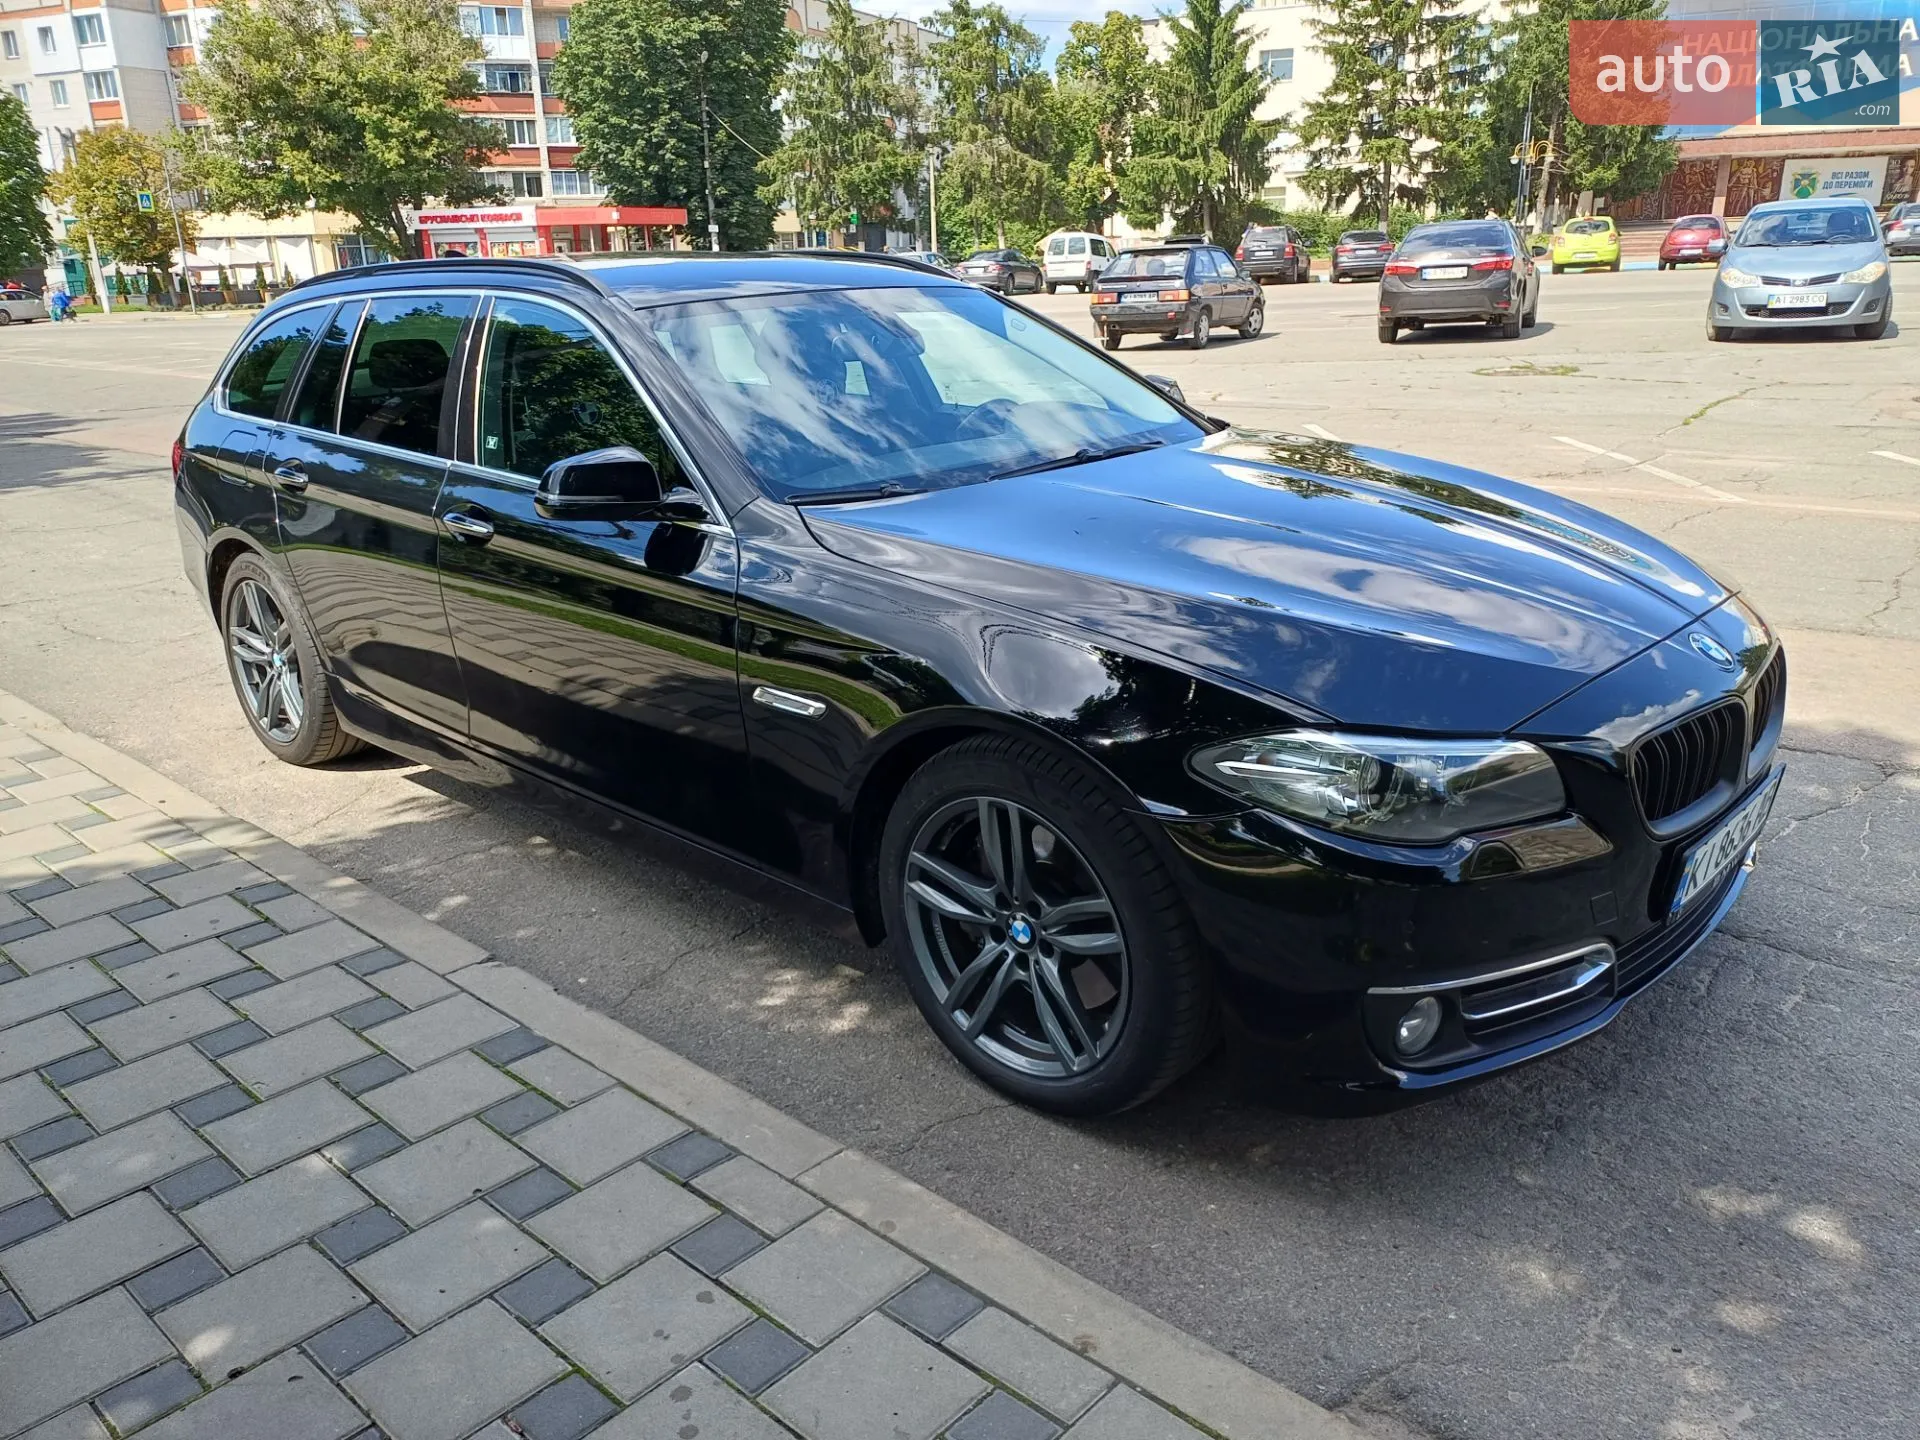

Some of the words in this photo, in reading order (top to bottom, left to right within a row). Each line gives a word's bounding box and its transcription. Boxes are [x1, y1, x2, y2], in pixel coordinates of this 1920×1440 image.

[1831, 171, 1844, 180] ВСІ
[1844, 171, 1870, 180] РАЗОМ
[1822, 181, 1834, 190] ДО
[1834, 180, 1874, 189] ПЕРЕМОГИ
